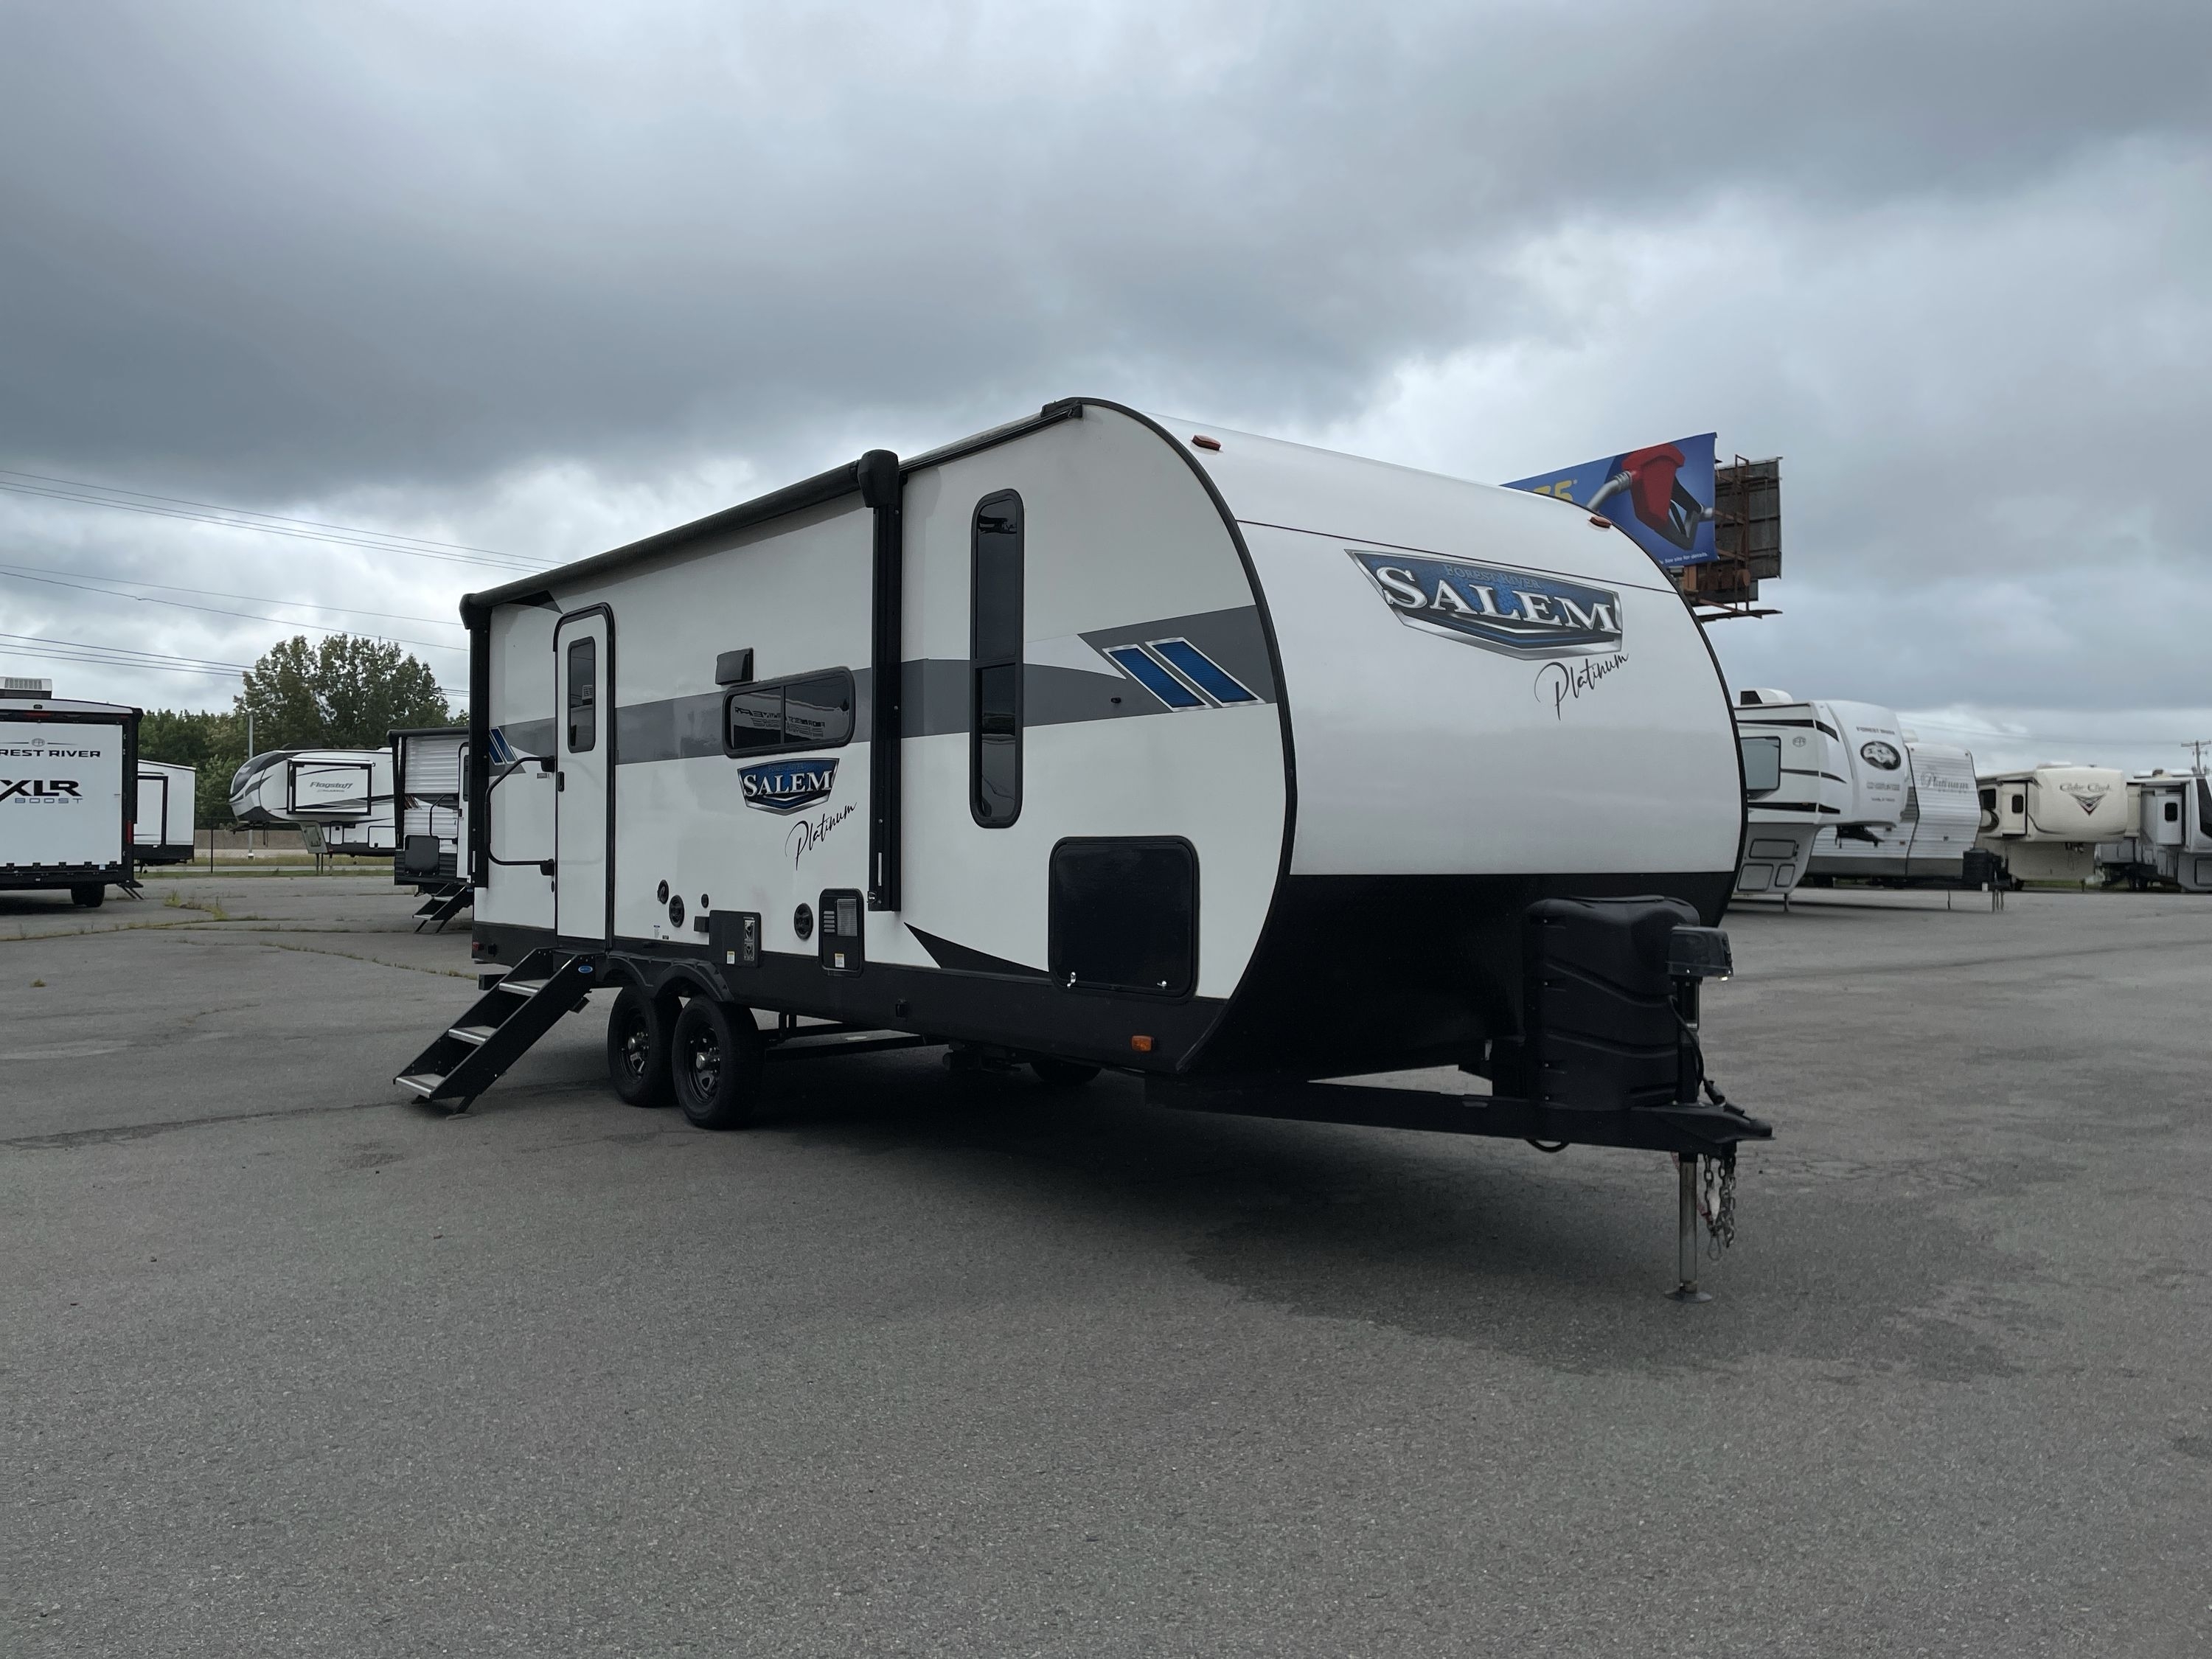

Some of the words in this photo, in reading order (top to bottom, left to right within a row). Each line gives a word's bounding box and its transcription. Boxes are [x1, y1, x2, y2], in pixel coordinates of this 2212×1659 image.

[1376, 566, 1622, 634] SALEM
[1534, 653, 1629, 721] Platinum
[49, 750, 101, 758] RIVER
[0, 779, 83, 802] XLR
[743, 771, 832, 797] SALEM
[785, 802, 857, 871] Platinum
